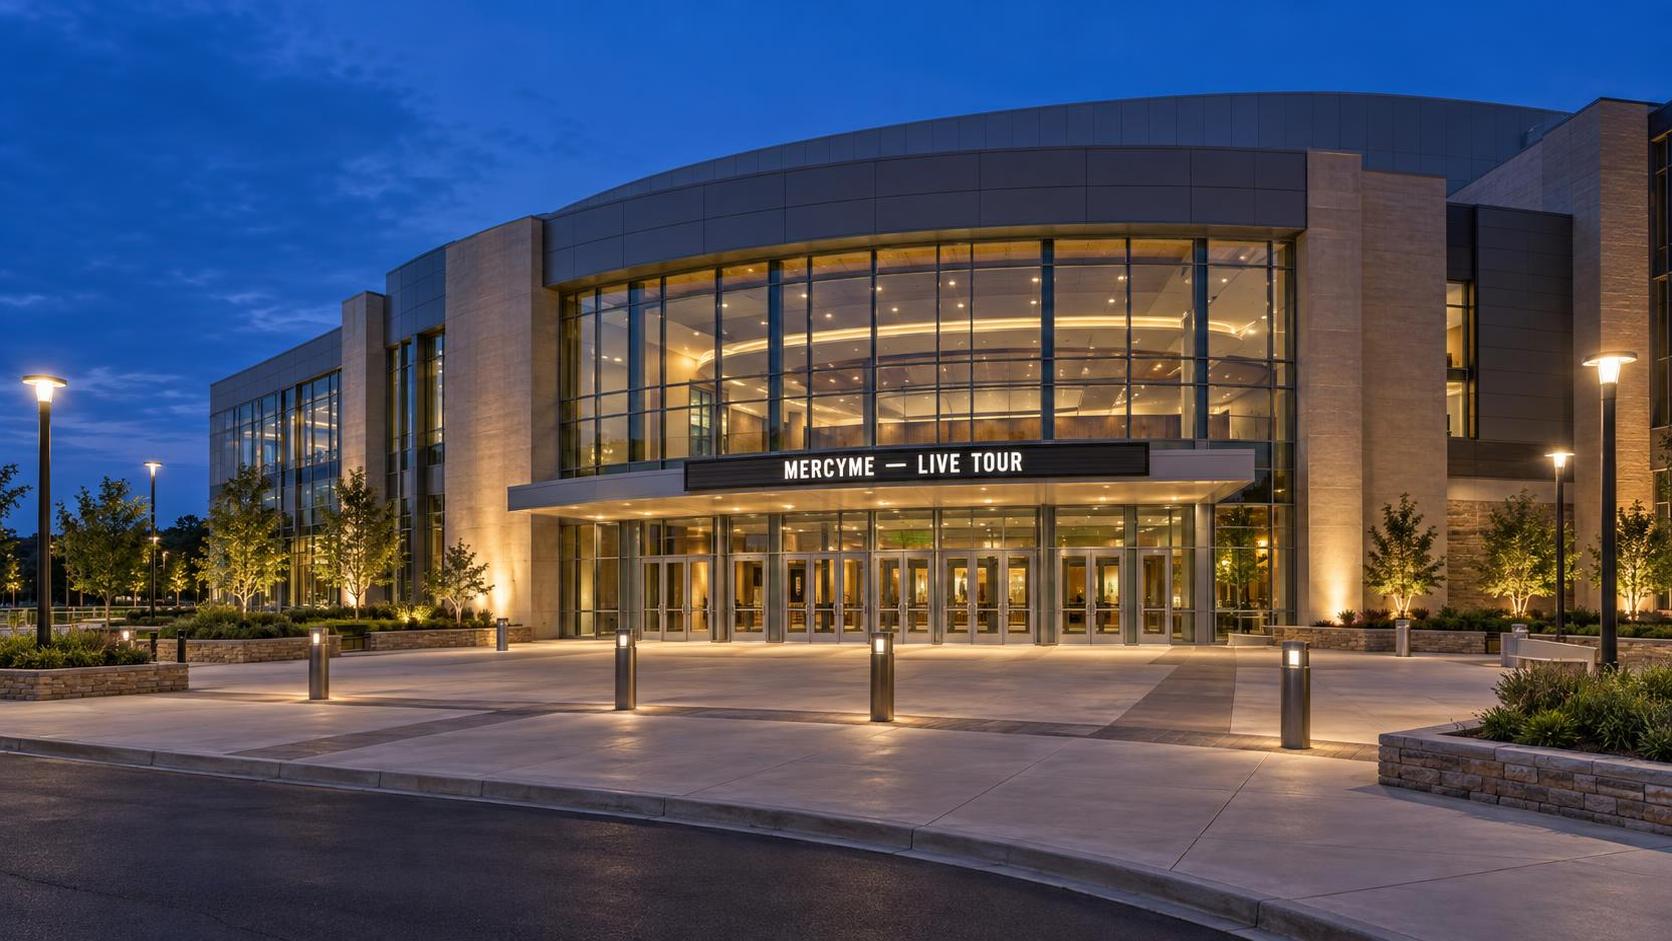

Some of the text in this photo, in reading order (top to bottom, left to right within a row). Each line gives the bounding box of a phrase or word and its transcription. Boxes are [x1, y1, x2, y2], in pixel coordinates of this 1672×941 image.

[784, 456, 875, 480] MERCYME
[918, 453, 961, 475] LIVE
[970, 451, 1023, 473] TOUR
